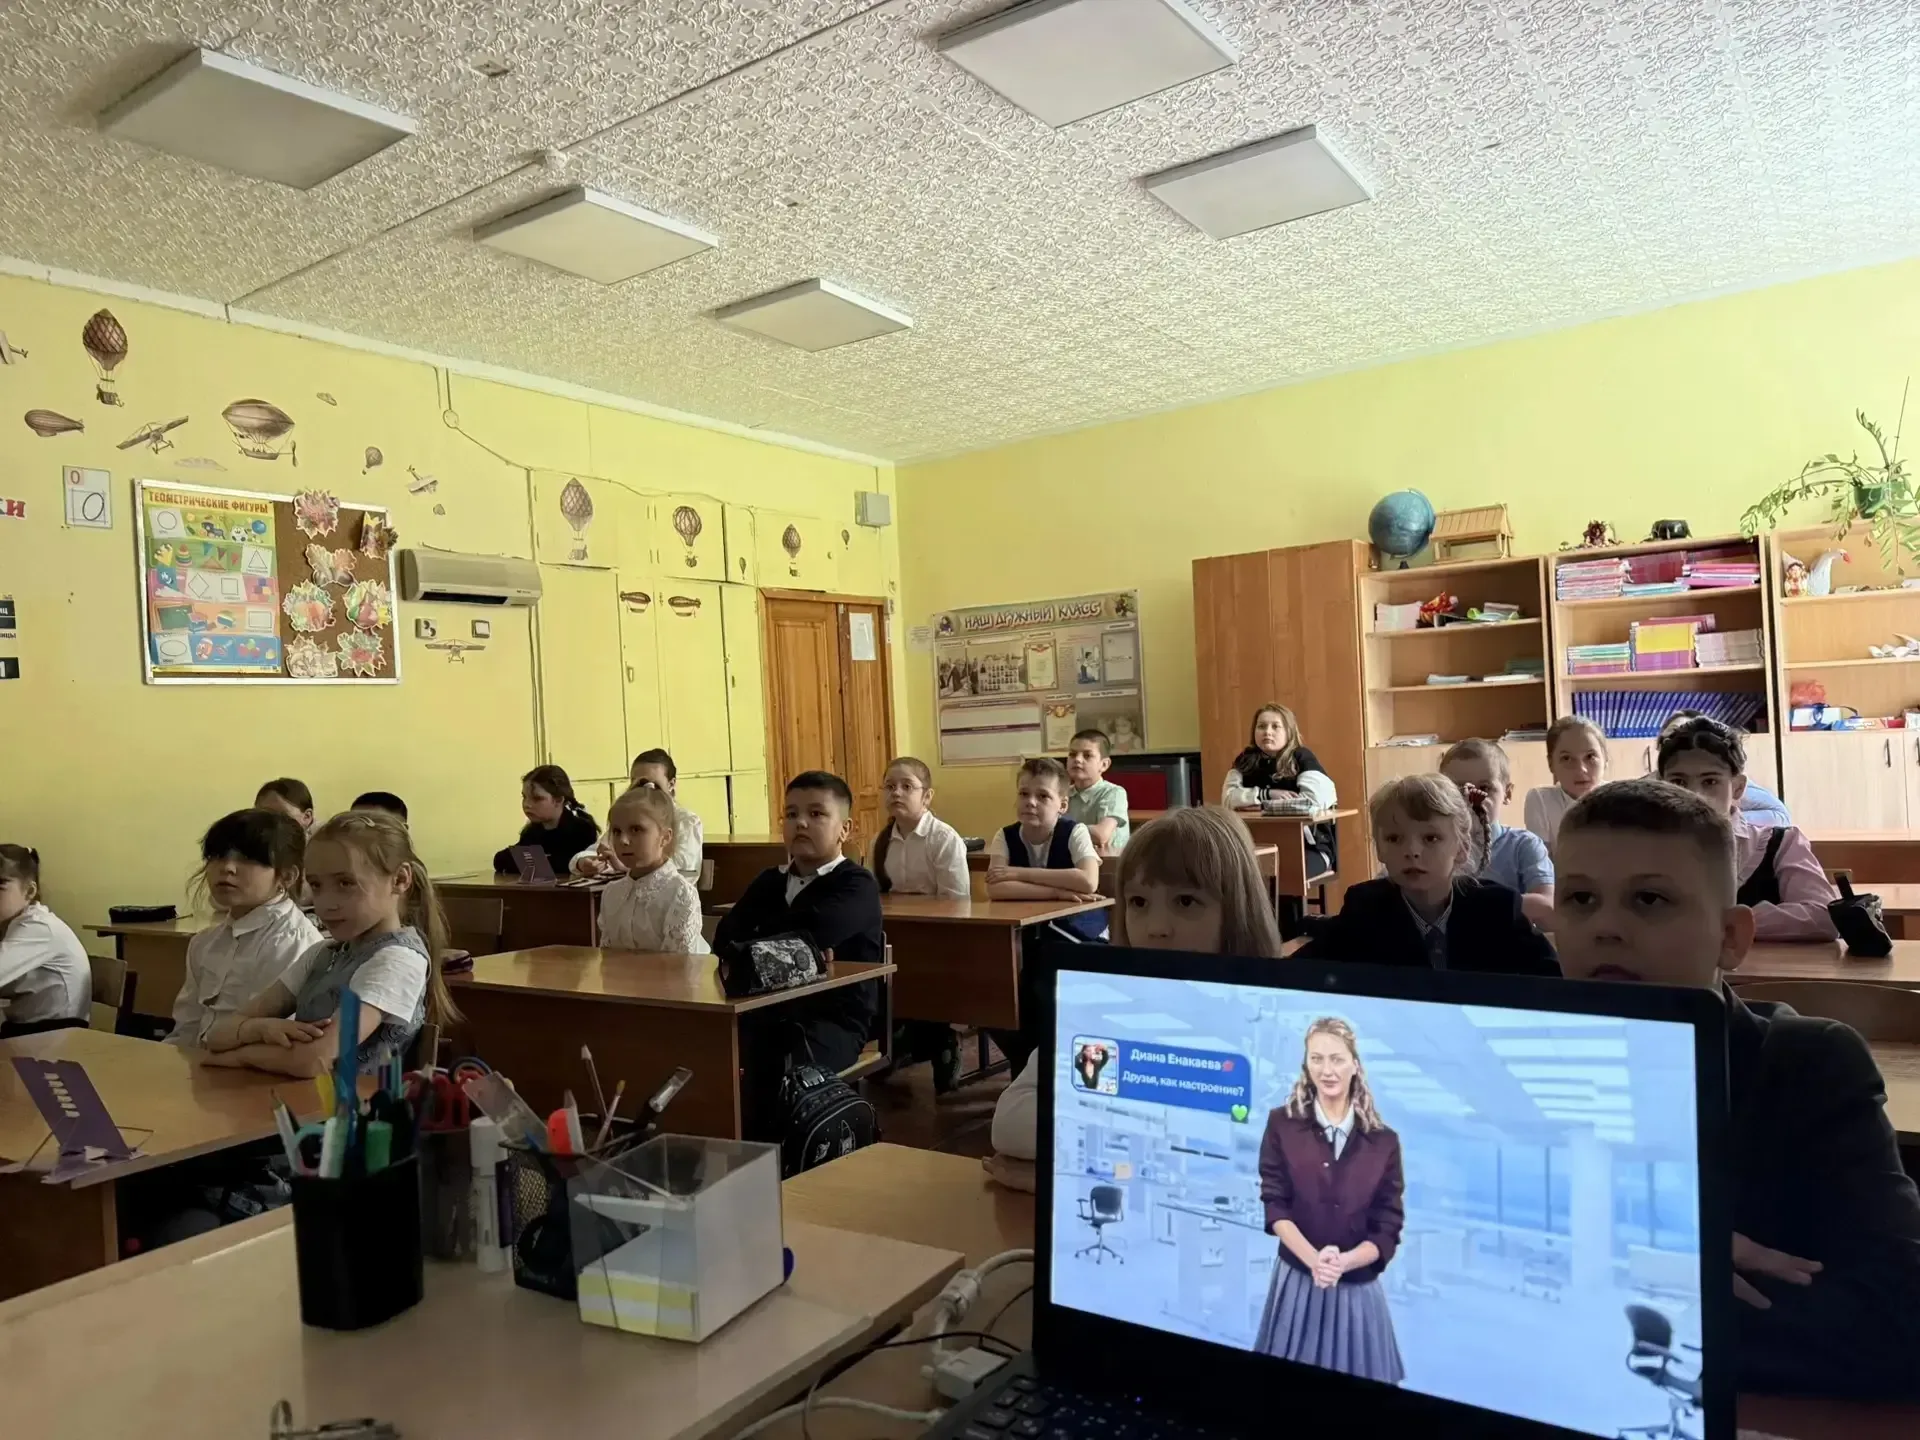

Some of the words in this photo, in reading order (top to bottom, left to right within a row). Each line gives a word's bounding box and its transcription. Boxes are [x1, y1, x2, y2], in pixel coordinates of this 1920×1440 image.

[0, 497, 26, 518] И
[149, 491, 229, 510] ГЕОМЕТРИЧЕСКИЕ
[231, 500, 269, 514] ФИГУРЫ
[965, 614, 993, 632] НАШ
[994, 605, 1054, 628] ДРУЖНЫЙ
[1057, 600, 1102, 620] КЛАСС
[1130, 1048, 1166, 1065] Диана
[1167, 1053, 1222, 1071] Енакаева
[1122, 1070, 1159, 1086] Друзья,
[1160, 1077, 1178, 1088] как
[1178, 1081, 1245, 1097] настроение?
